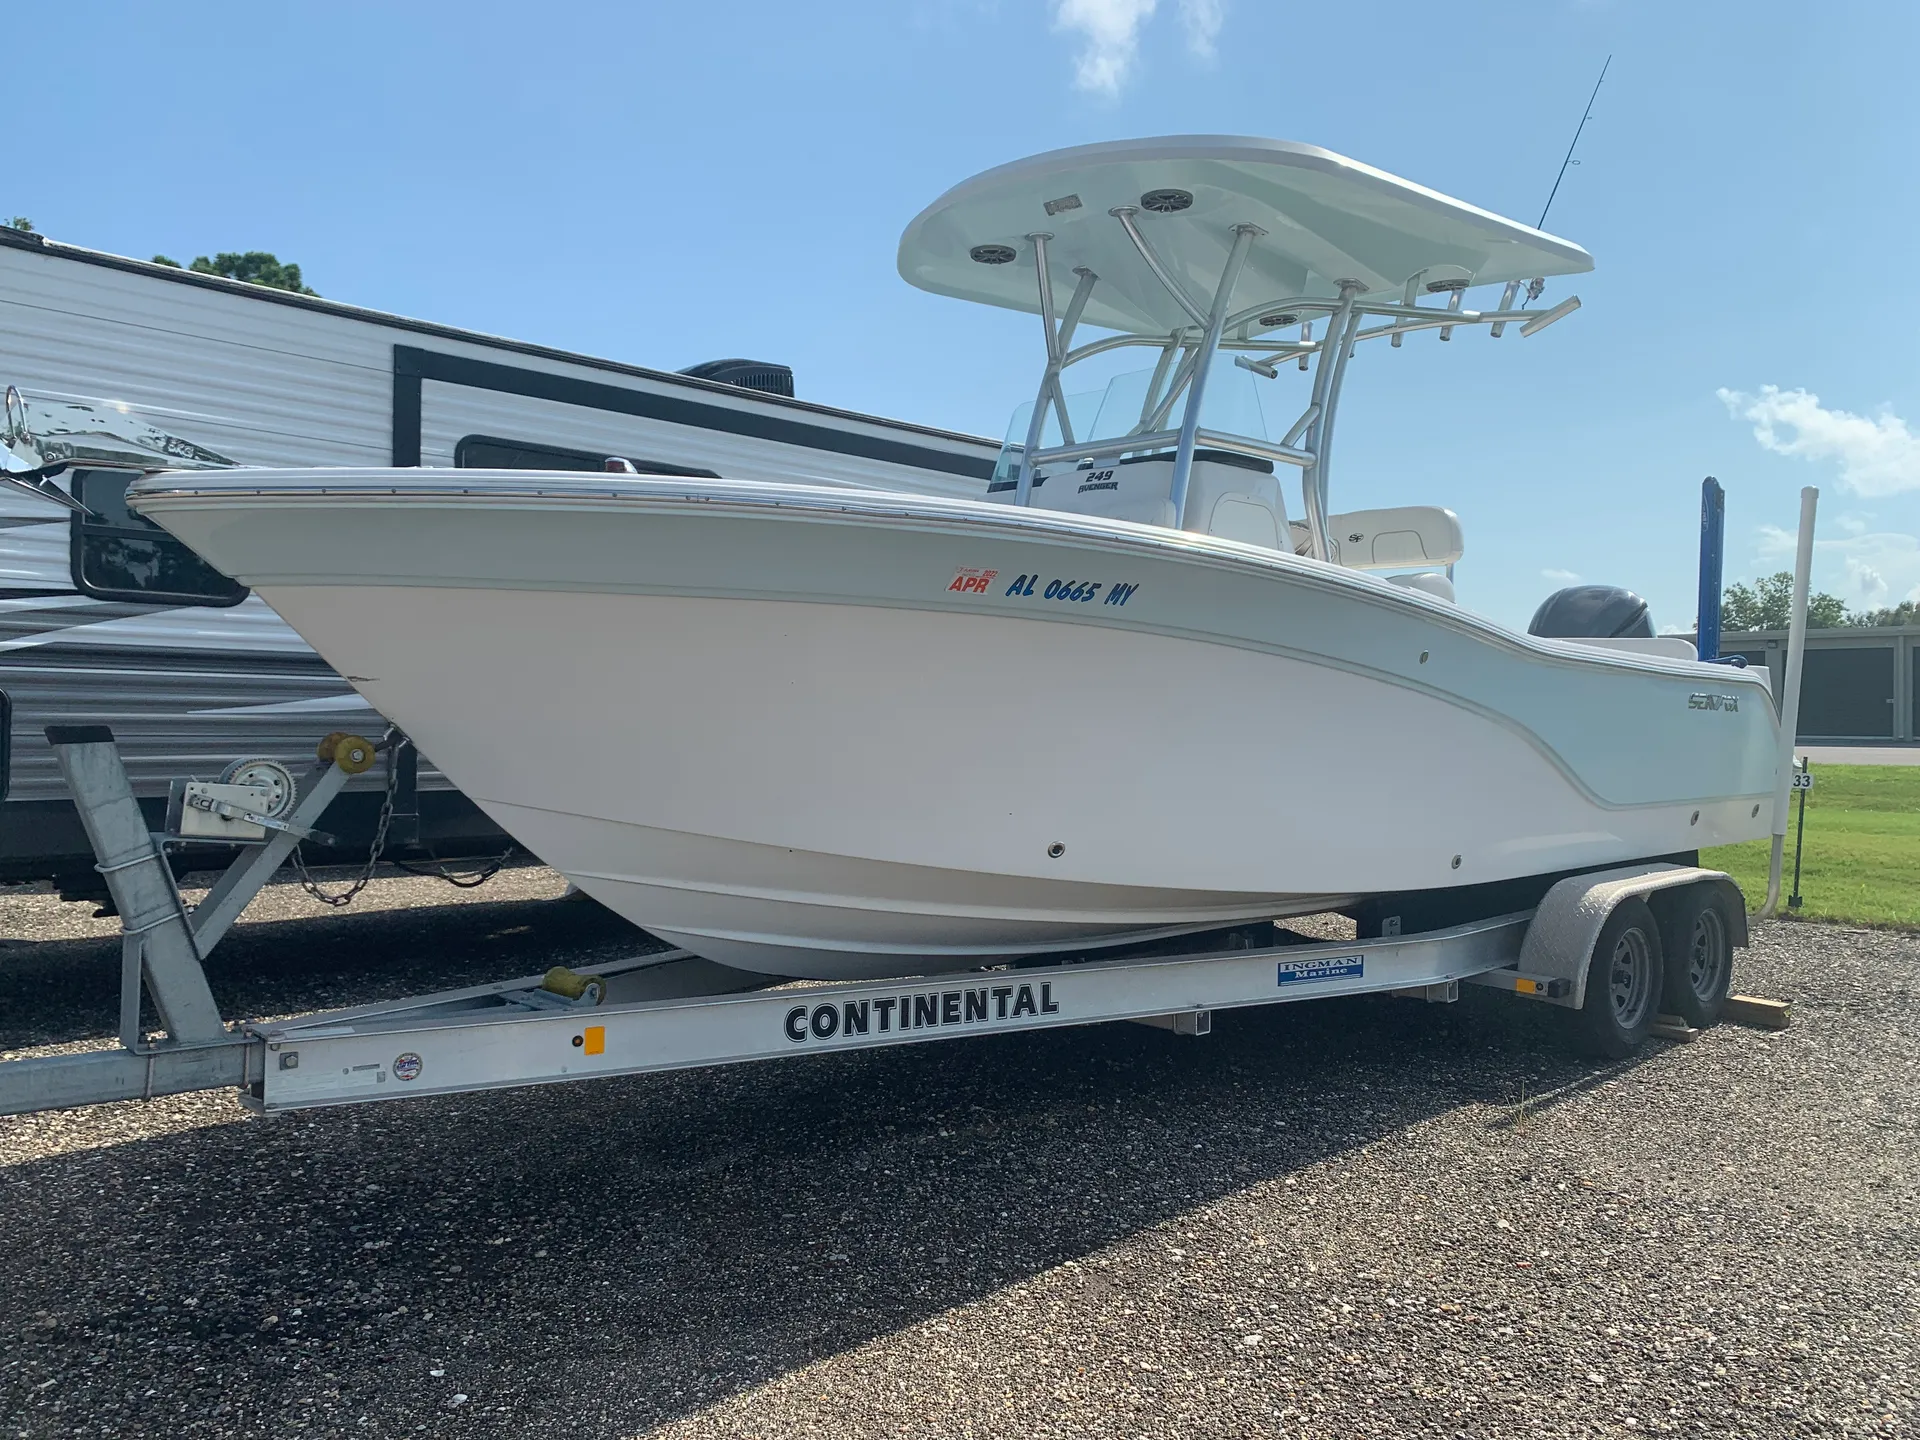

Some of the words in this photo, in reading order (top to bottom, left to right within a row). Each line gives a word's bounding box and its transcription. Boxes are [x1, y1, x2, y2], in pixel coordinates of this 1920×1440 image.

[1086, 470, 1114, 482] 249
[1077, 482, 1119, 494] AVENGER
[948, 576, 990, 593] APR
[1005, 574, 1039, 597] AL
[1043, 579, 1102, 603] 0665
[1103, 583, 1140, 606] MY
[1284, 957, 1358, 971] INGMAN
[1294, 967, 1348, 979] Marine
[784, 981, 1060, 1043] CONTINENTAL
